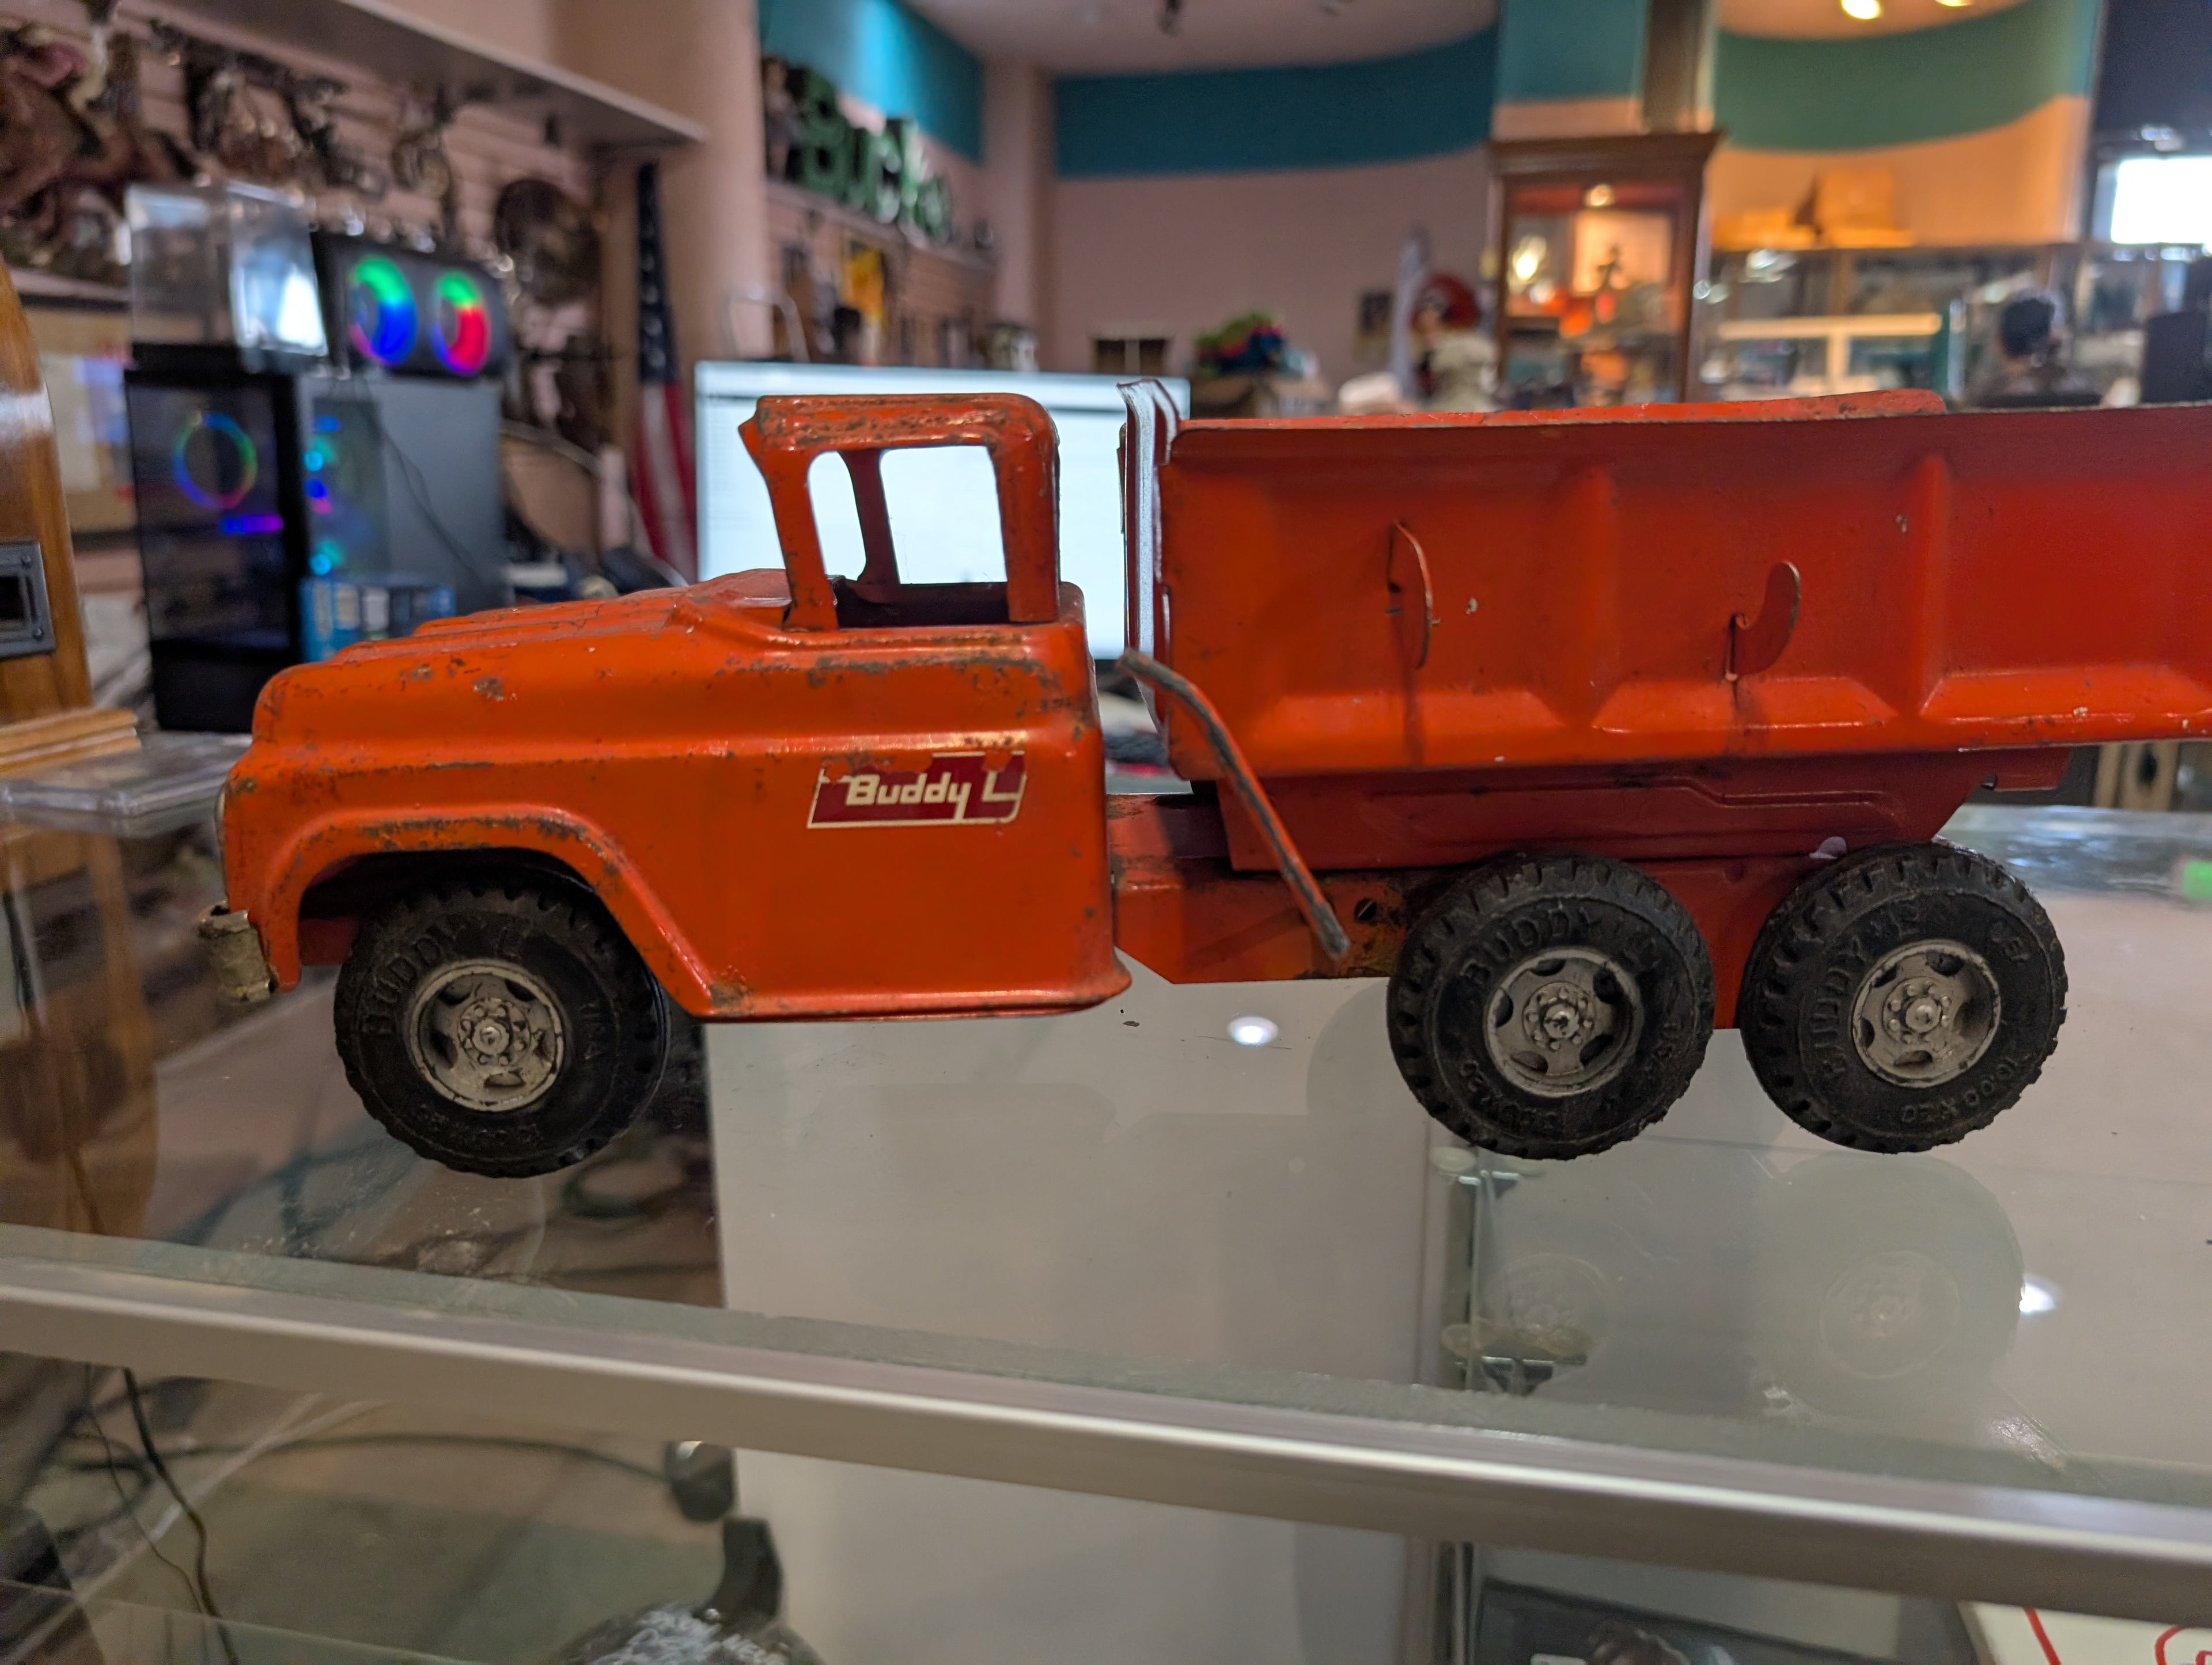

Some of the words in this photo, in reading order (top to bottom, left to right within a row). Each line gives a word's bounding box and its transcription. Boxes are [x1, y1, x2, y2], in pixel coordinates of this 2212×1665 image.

[846, 771, 972, 822] Buddy
[983, 771, 1021, 802] L
[1461, 905, 1596, 980] BUDDY
